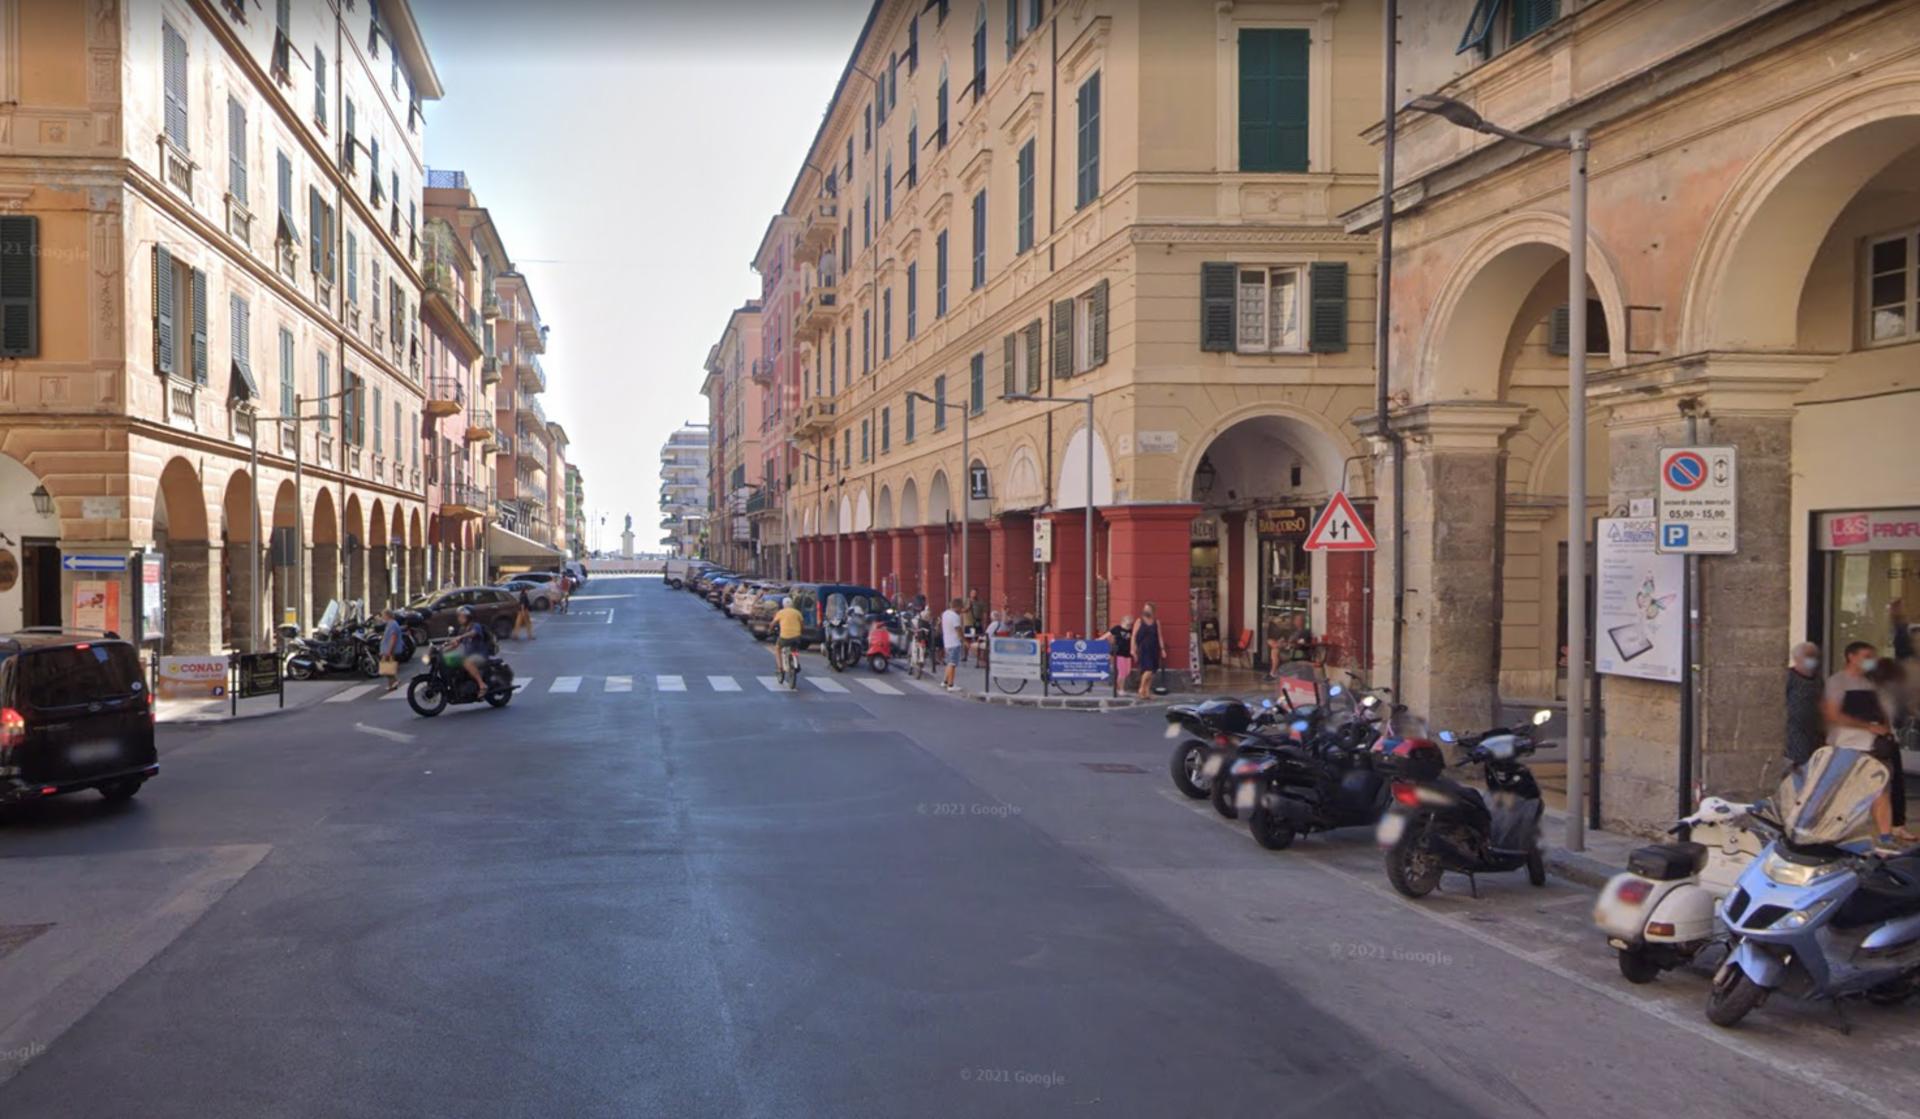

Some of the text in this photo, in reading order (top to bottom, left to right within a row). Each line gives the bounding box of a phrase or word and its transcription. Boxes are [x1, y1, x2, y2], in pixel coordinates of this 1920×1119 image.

[1668, 526, 1686, 545] P
[1833, 517, 1868, 536] L&S
[181, 663, 224, 673] CONAD
